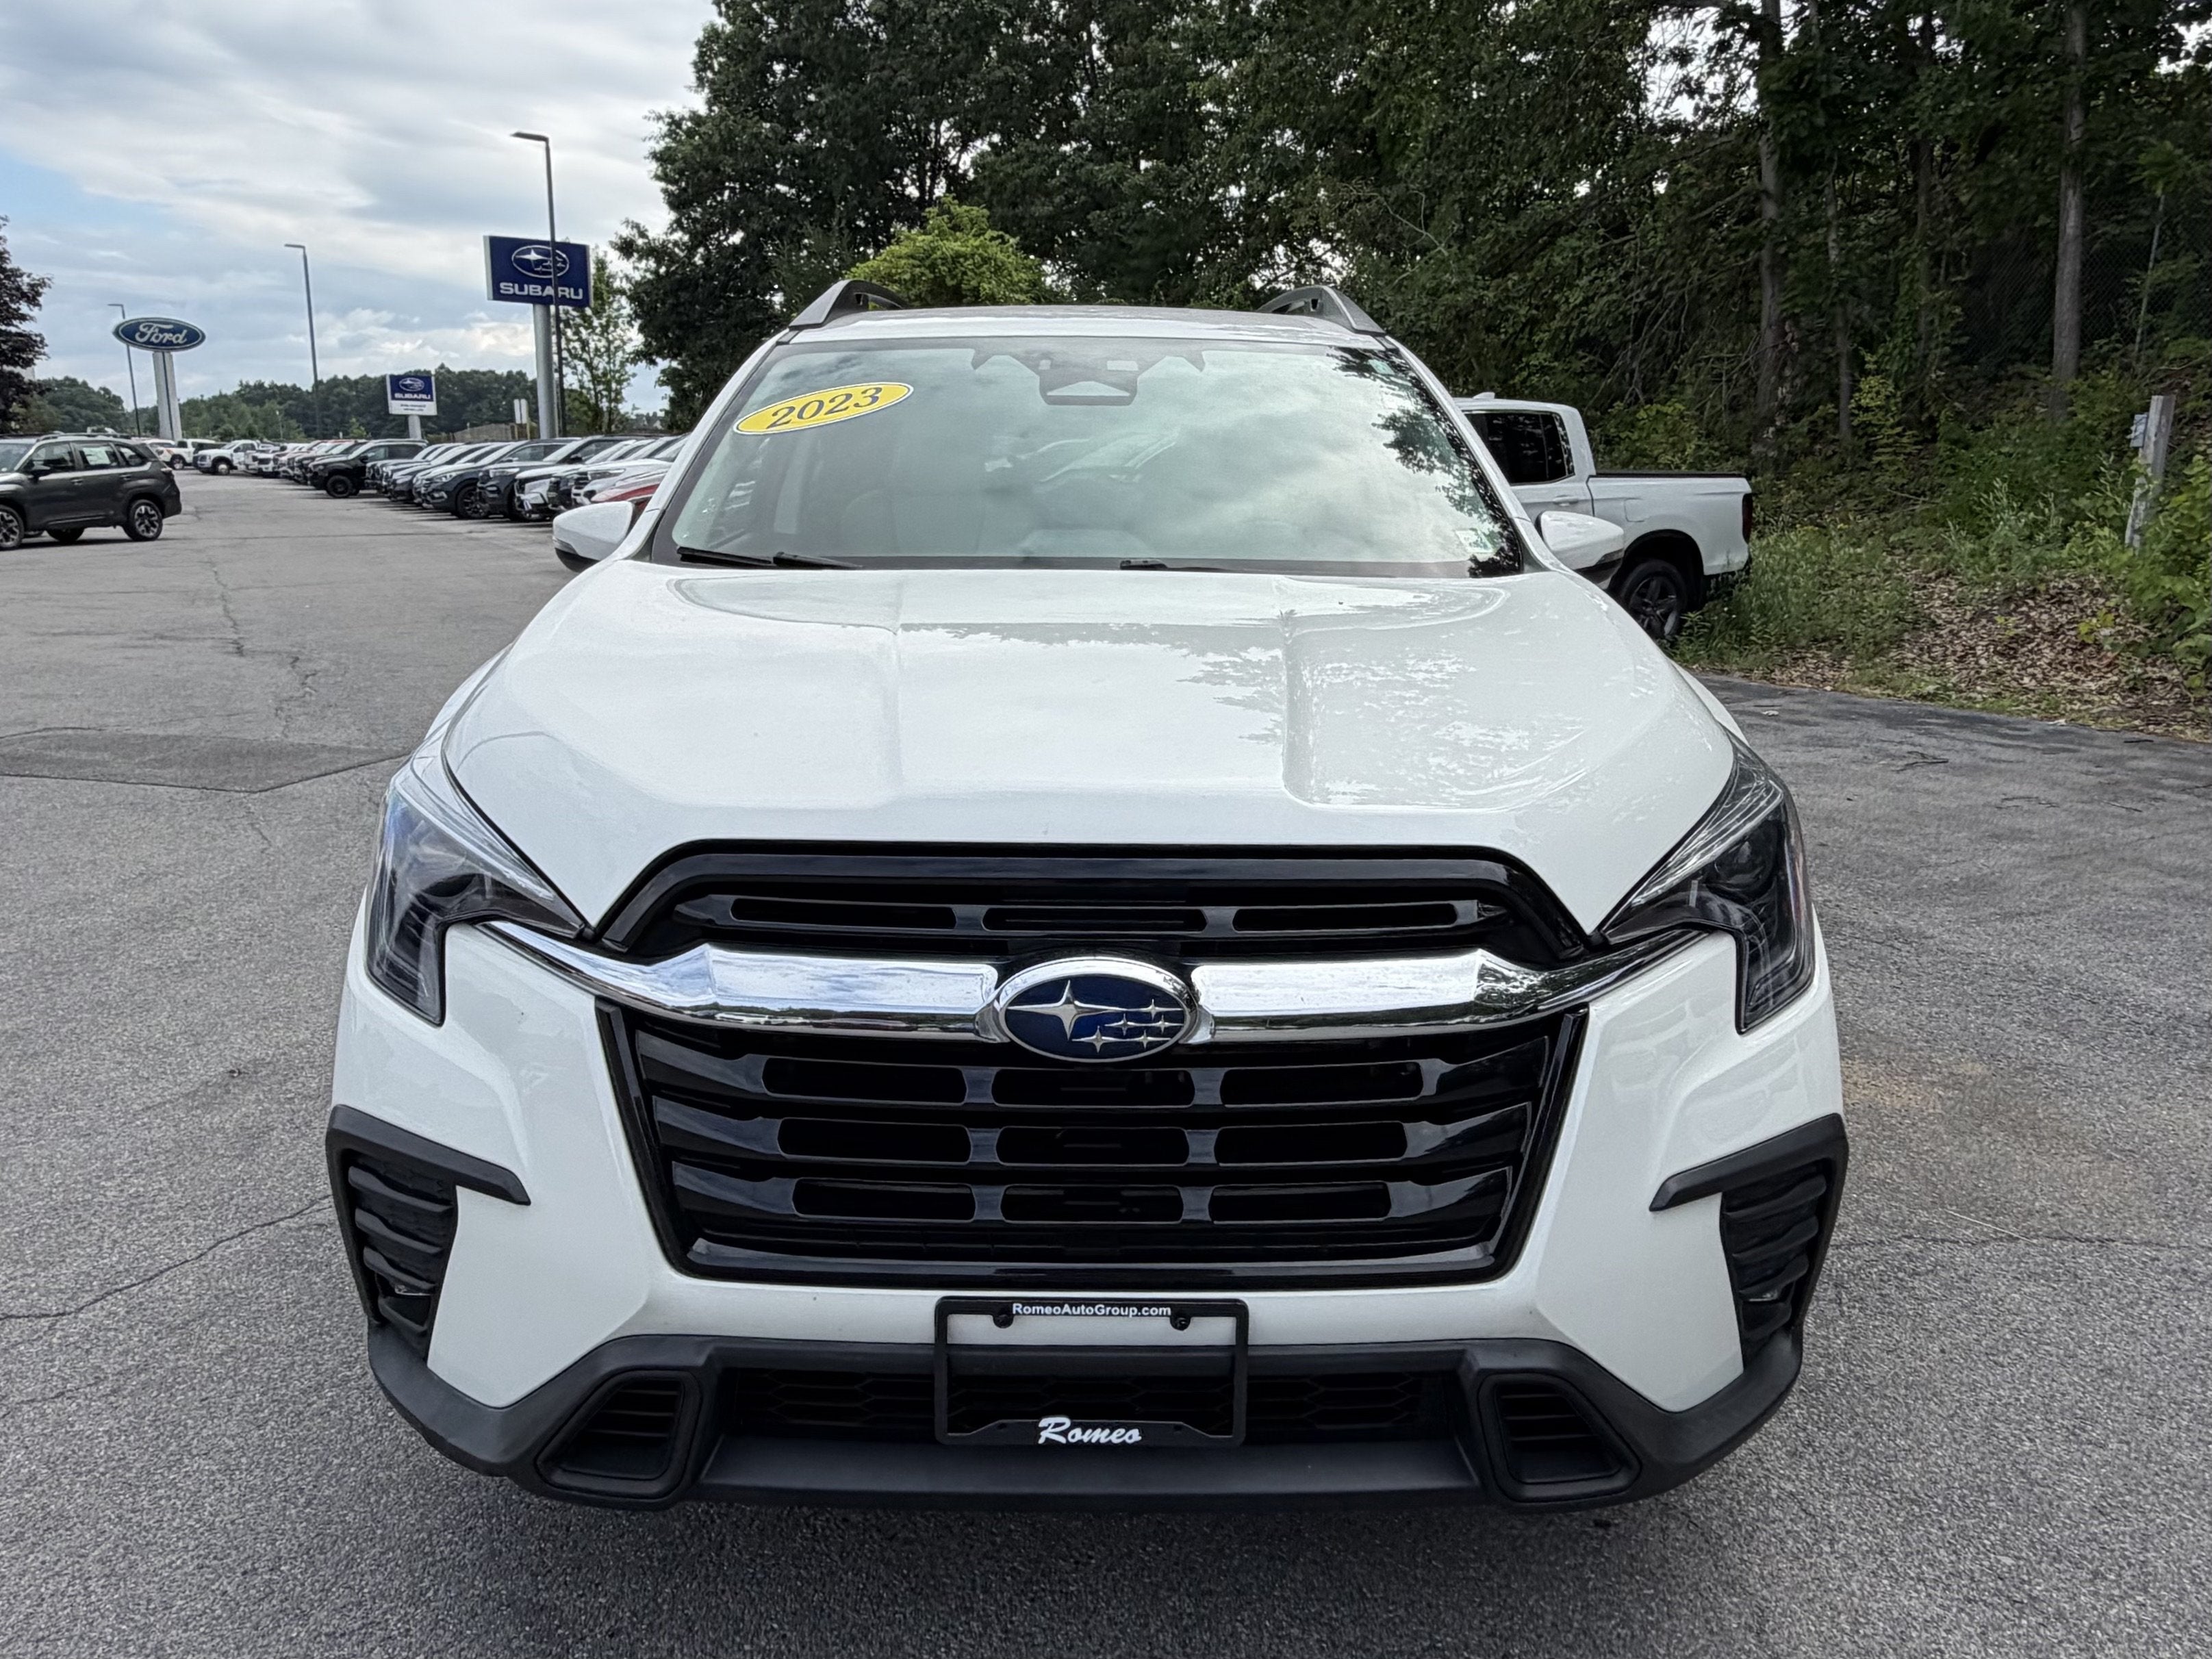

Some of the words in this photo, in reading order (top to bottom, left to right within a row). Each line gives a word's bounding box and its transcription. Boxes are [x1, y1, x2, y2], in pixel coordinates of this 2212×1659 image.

[499, 281, 583, 300] SUBARU
[135, 322, 188, 344] Ford
[765, 387, 883, 429] 2023
[1012, 1302, 1171, 1318] RomeoAutoGroup.com
[1037, 1416, 1143, 1444] Romeo
